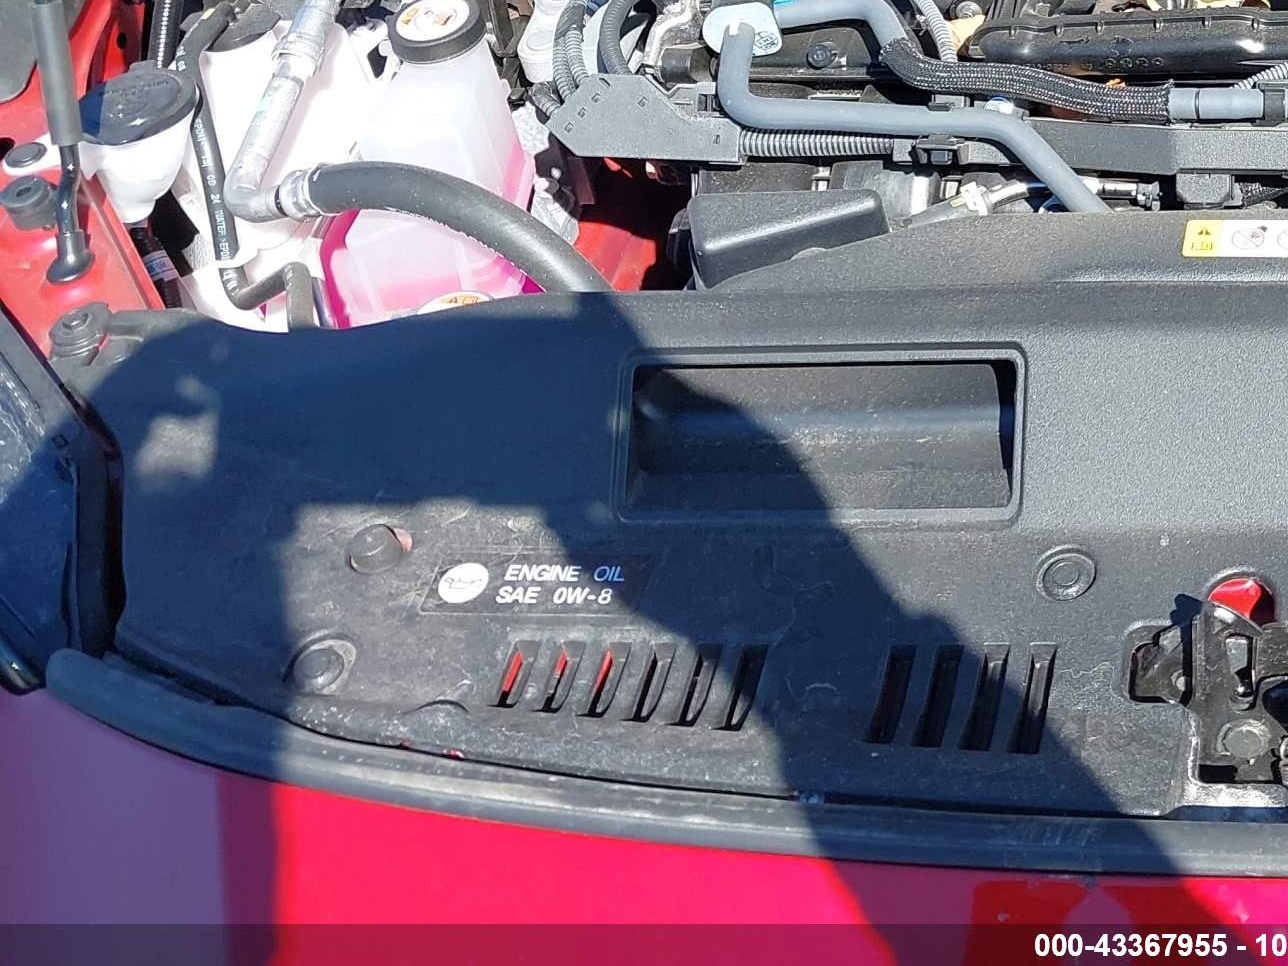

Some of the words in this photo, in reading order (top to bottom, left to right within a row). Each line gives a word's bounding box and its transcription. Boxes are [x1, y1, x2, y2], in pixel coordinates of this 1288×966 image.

[504, 564, 581, 581] ENGINE
[593, 565, 624, 581] OIL
[495, 585, 541, 603] SAE
[552, 586, 612, 604] 0W-8
